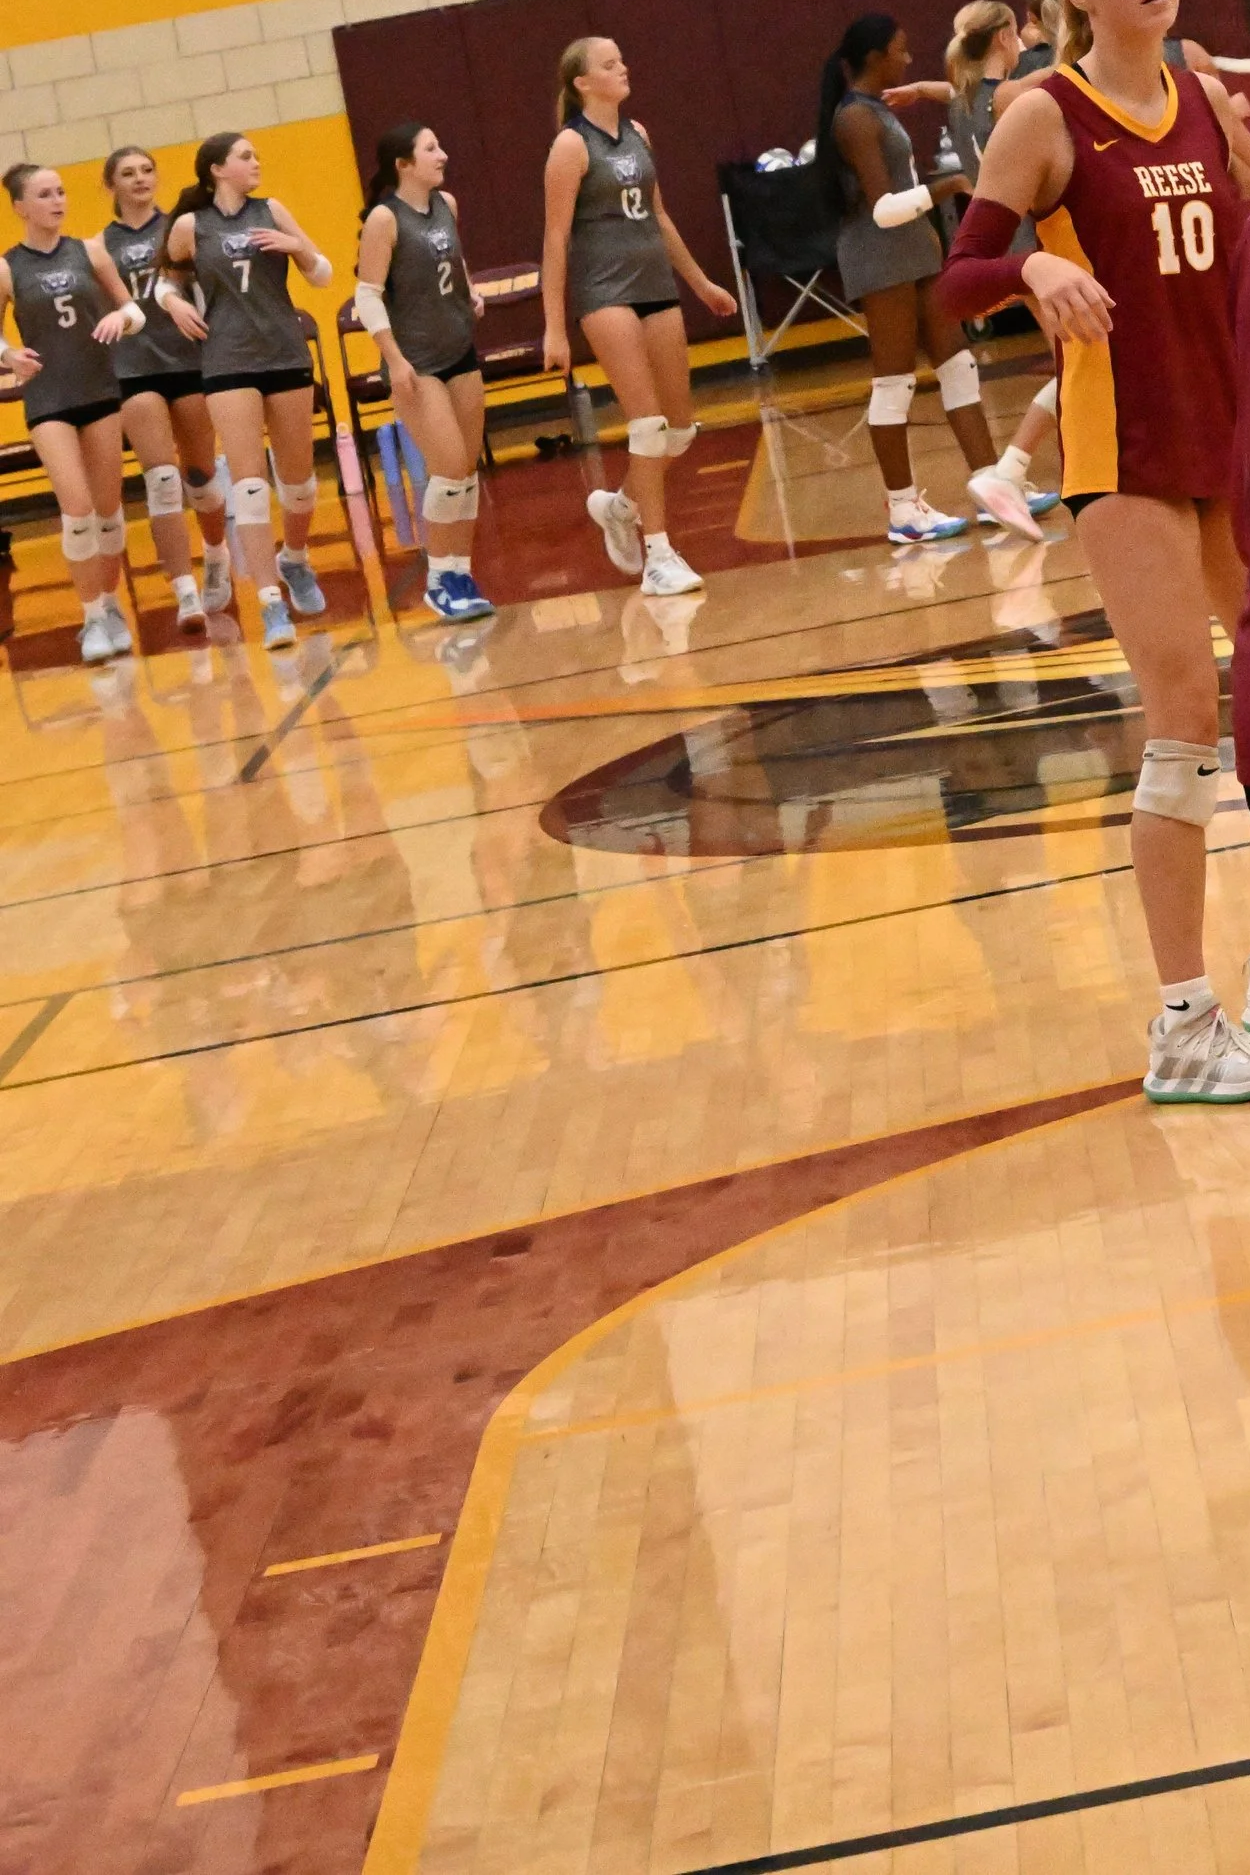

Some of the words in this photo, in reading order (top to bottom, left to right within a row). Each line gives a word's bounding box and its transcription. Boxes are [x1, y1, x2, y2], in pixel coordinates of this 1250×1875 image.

[1133, 161, 1213, 198] REESE
[620, 187, 649, 220] 12
[1151, 200, 1216, 275] 10
[129, 267, 156, 300] 17
[232, 260, 251, 293] 7
[437, 261, 453, 296] 2
[54, 294, 78, 328] 5
